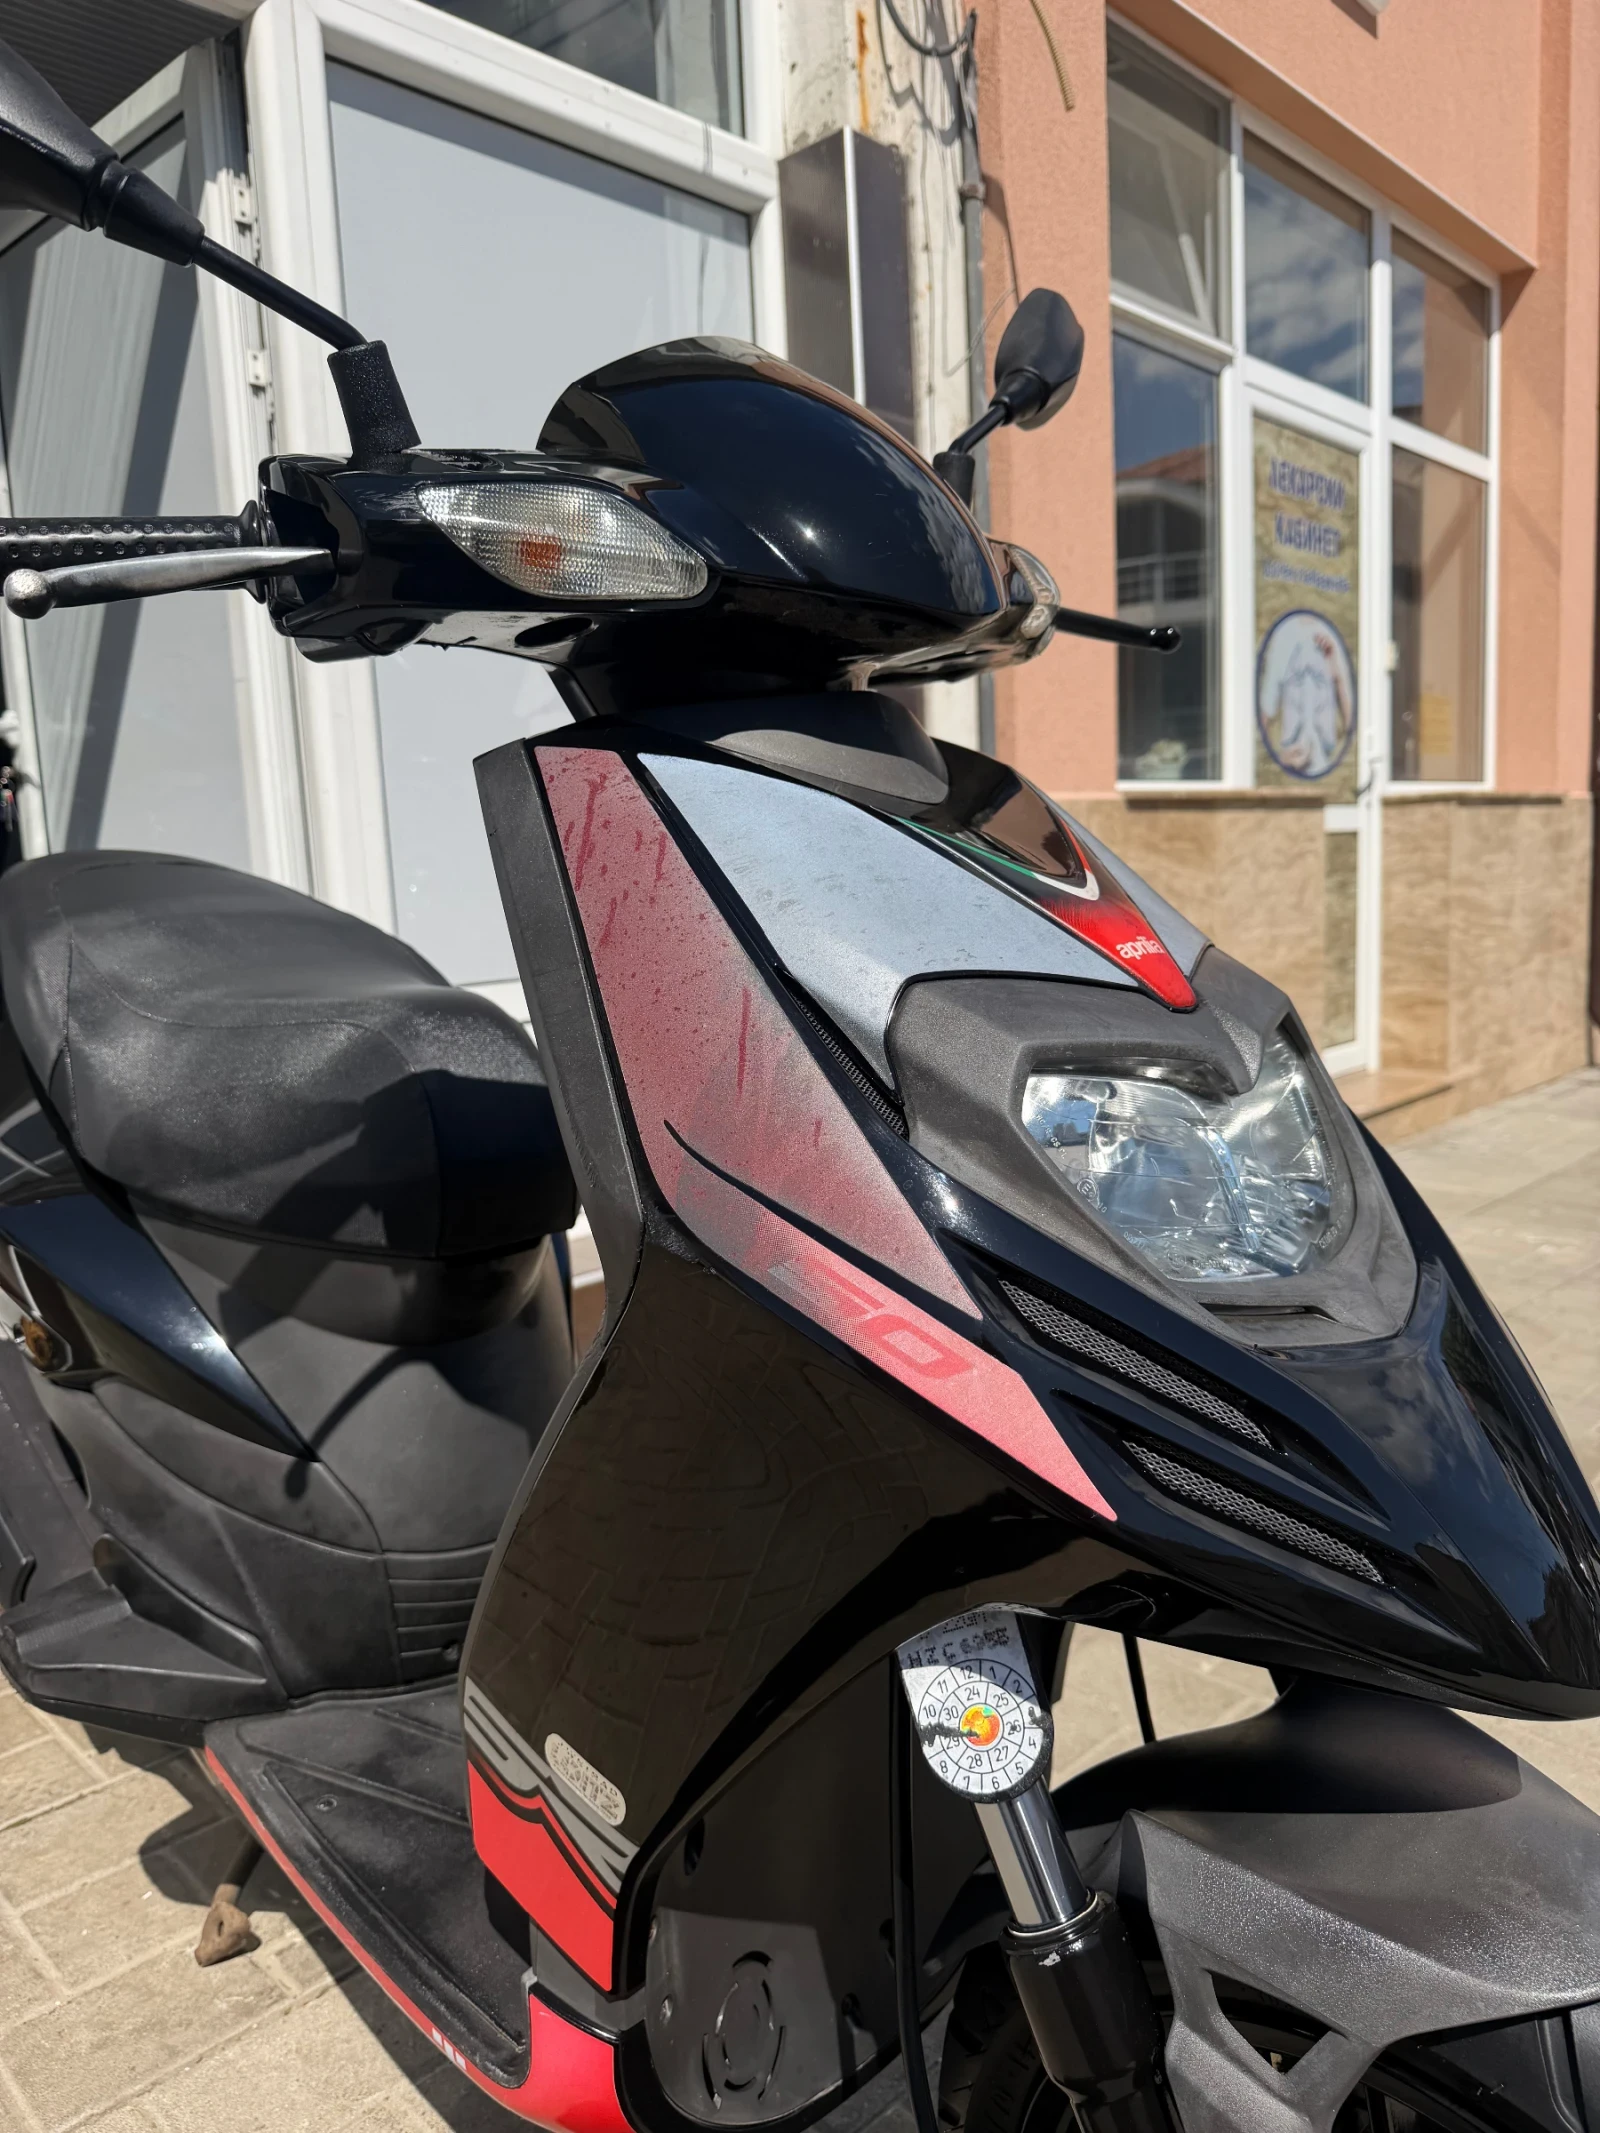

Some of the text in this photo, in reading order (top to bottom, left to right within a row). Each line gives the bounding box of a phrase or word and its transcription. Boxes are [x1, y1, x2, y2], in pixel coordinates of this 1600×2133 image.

[1115, 935, 1166, 960] aprilia
[960, 1664, 974, 1679] 12
[989, 1666, 997, 1679] 1
[936, 1679, 950, 1693] 11
[964, 1685, 981, 1701] 24
[1012, 1679, 1023, 1693] 2
[992, 1692, 1009, 1708] 25
[922, 1704, 937, 1719] 10
[943, 1706, 959, 1721] 30
[1005, 1719, 1022, 1735] 26
[945, 1736, 961, 1750] 29
[1027, 1735, 1037, 1748] 4
[993, 1746, 1009, 1762] 27
[939, 1760, 949, 1774] 8
[966, 1753, 983, 1770] 28
[1015, 1761, 1024, 1775] 5
[963, 1776, 971, 1790] 7
[991, 1776, 1000, 1790] 6
